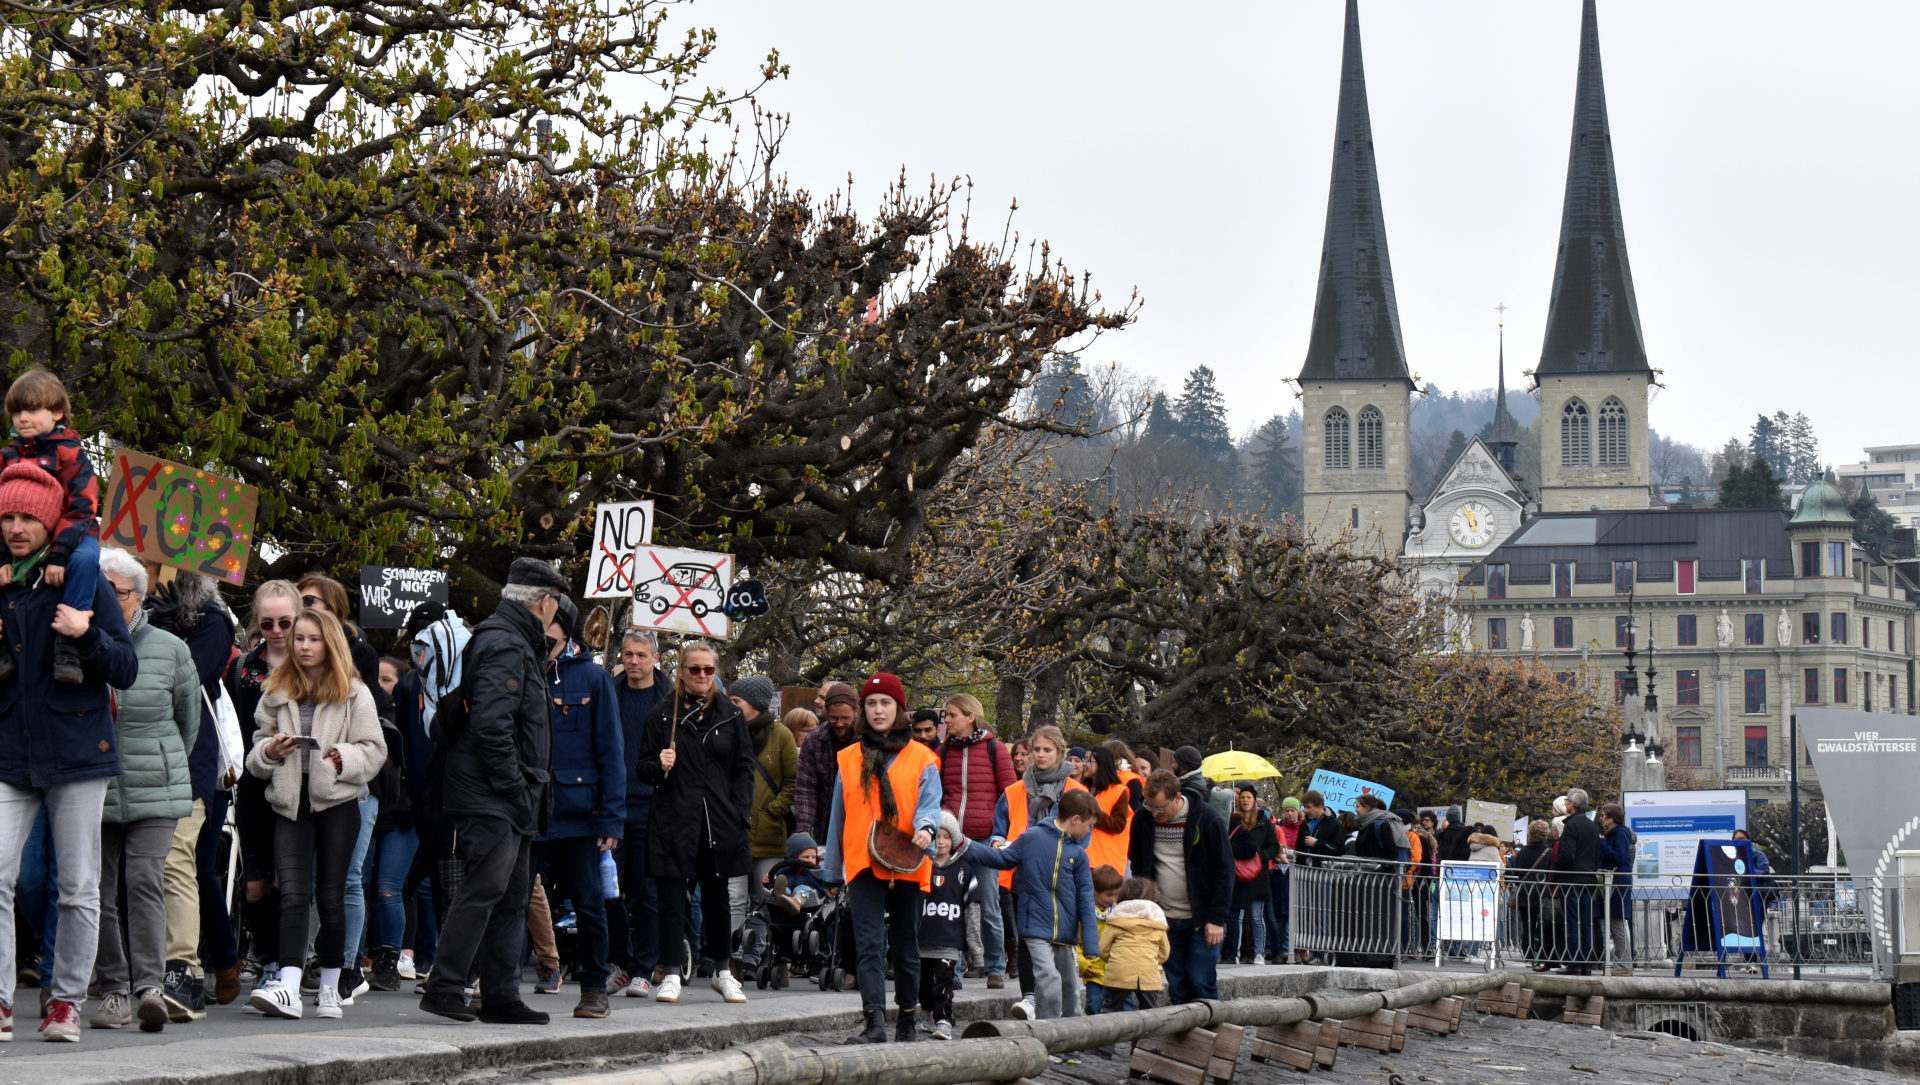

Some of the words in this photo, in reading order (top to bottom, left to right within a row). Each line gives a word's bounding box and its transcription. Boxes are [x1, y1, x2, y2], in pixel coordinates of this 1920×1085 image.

[599, 507, 646, 551] NO
[360, 584, 392, 608] WIR
[1854, 731, 1879, 741] VIER
[1824, 741, 1917, 752] WALDSTÄTTERSEE
[1317, 774, 1349, 789] MAKE
[1322, 790, 1344, 803] NOT
